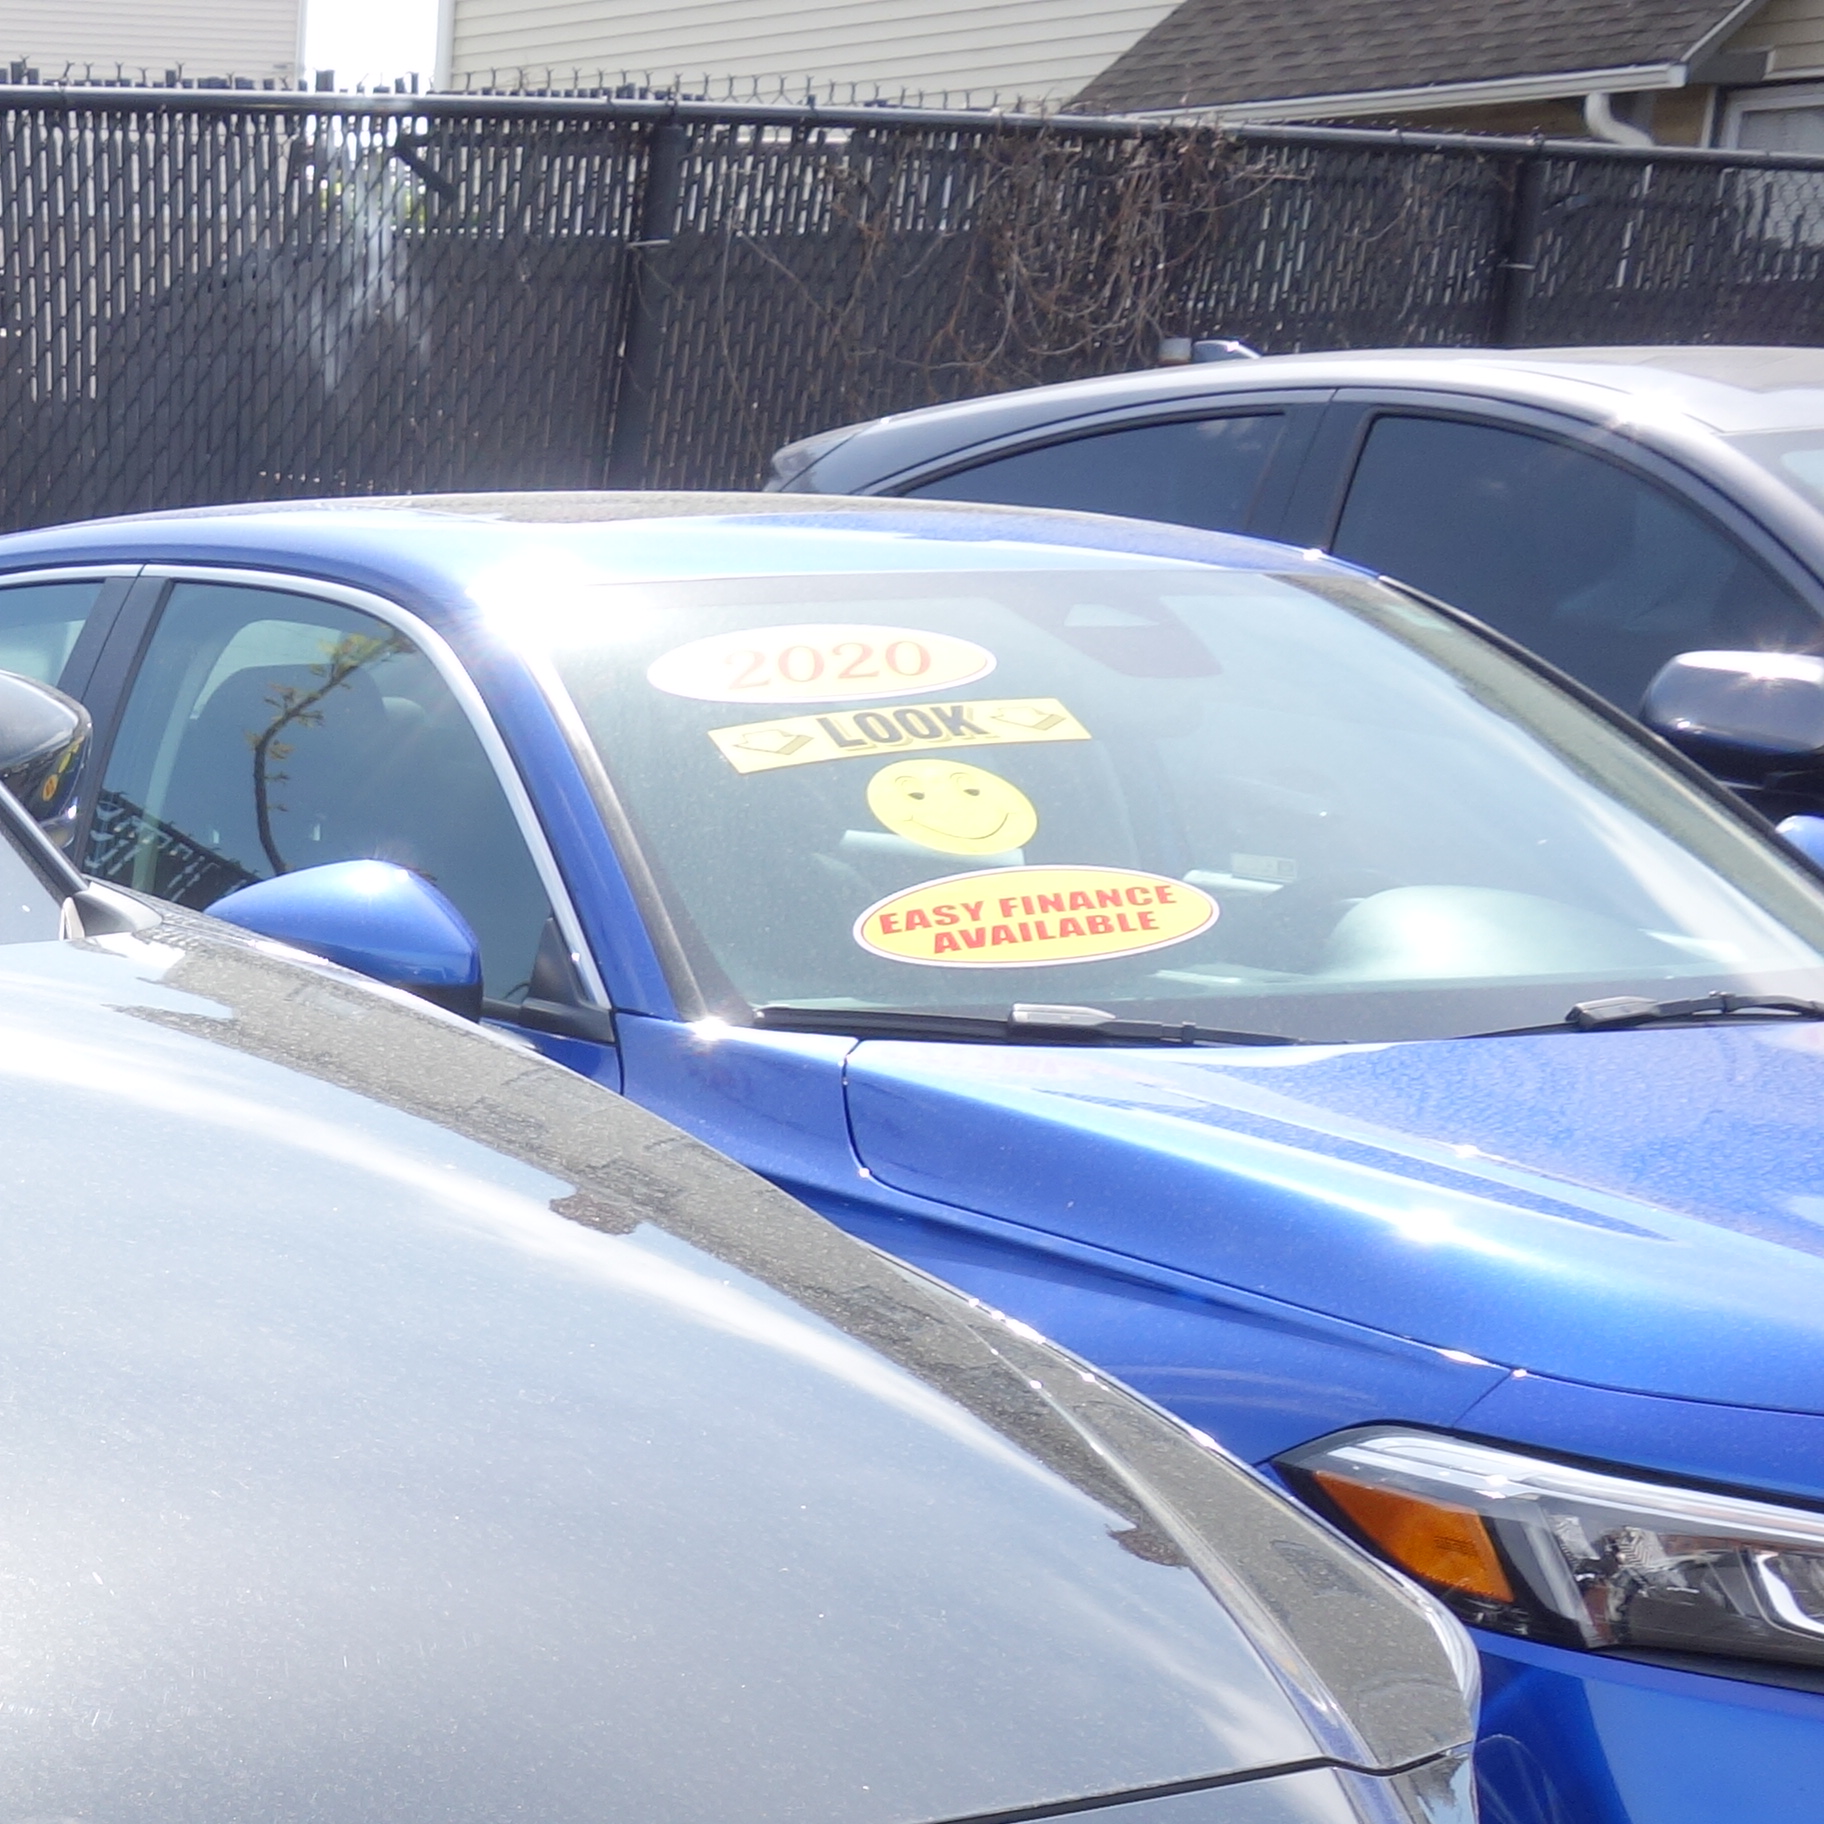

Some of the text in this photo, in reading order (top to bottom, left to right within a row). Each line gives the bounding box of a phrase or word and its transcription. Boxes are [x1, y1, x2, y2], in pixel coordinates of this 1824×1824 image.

[723, 640, 932, 690] 2020
[815, 704, 989, 749] LOOK
[879, 884, 1178, 935] EASY FINANCE
[933, 910, 1161, 954] AVAILABLE
